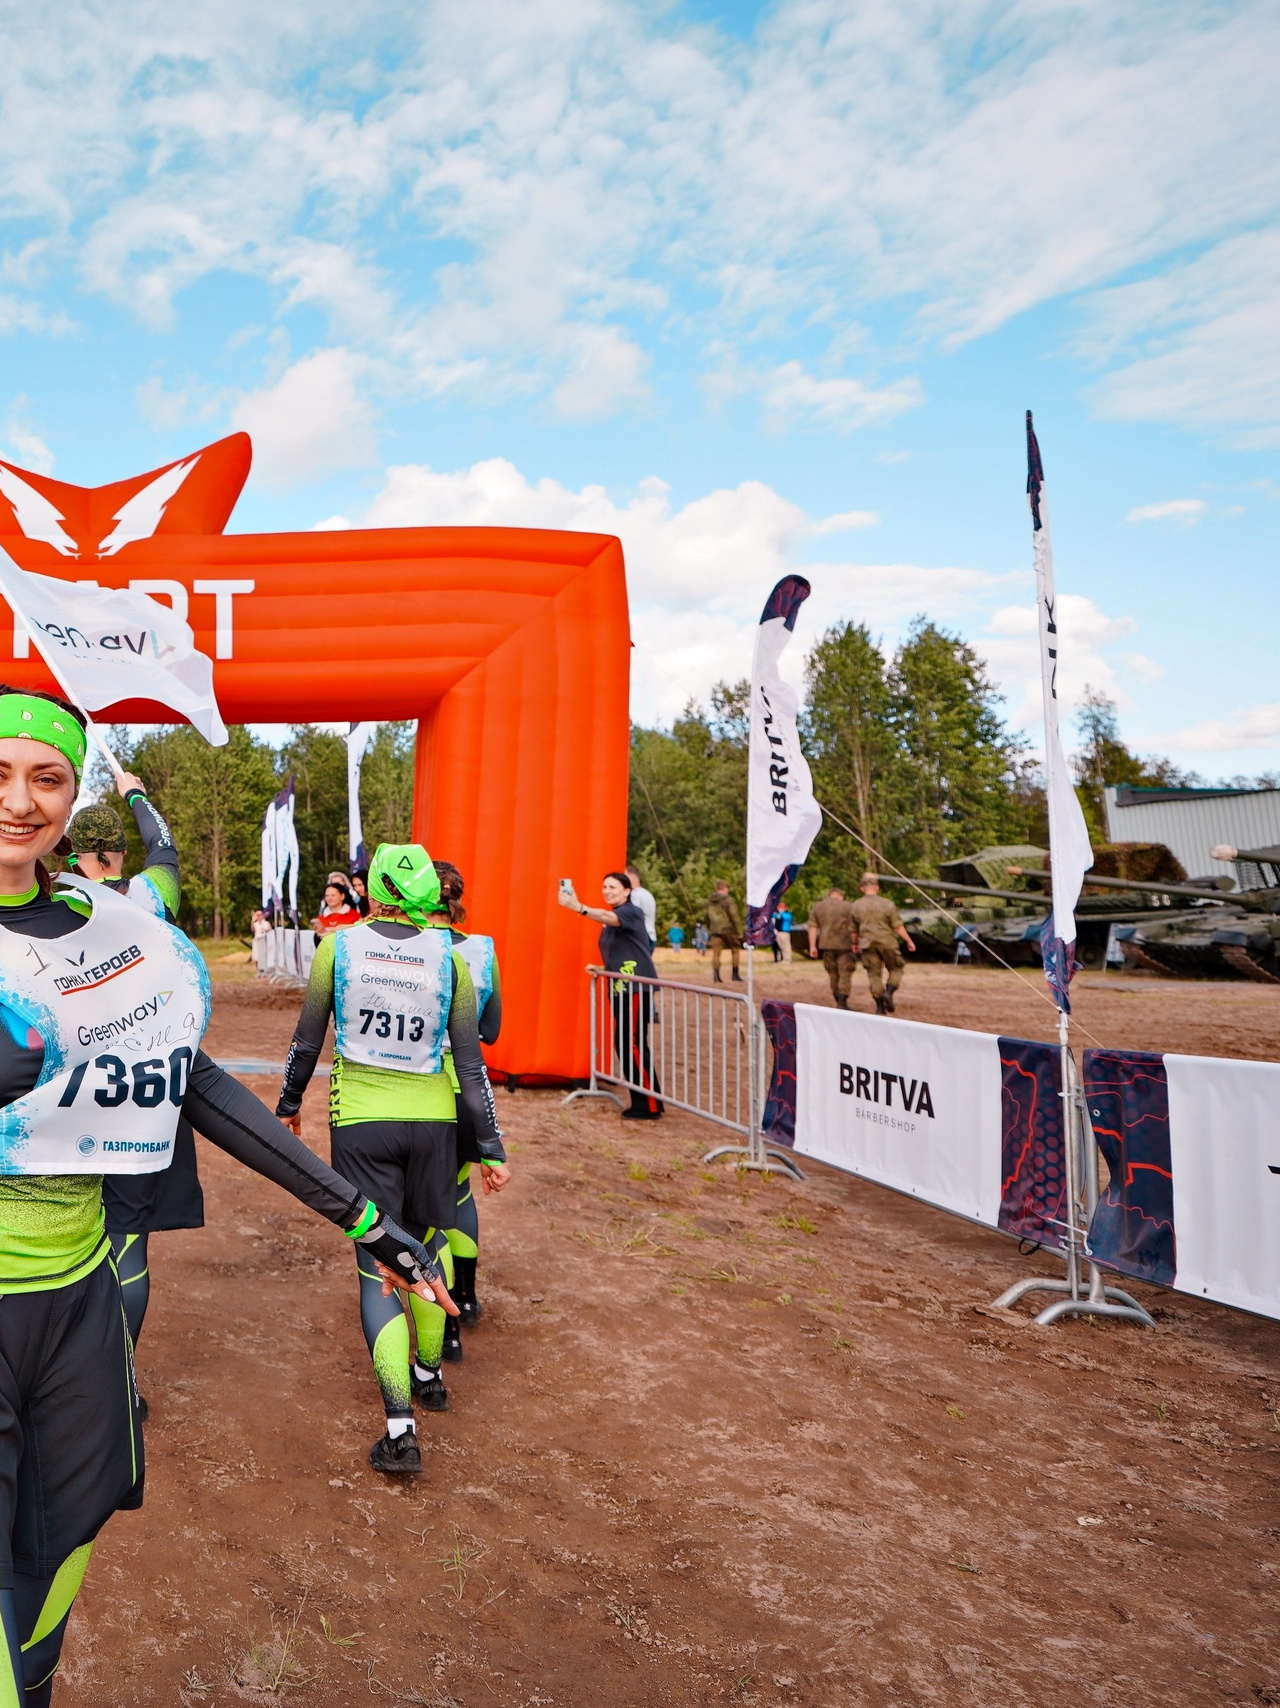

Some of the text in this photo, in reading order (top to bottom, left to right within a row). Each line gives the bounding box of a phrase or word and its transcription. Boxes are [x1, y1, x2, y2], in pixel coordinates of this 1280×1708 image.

[53, 944, 142, 991] ГОНКА ГЕРОЕВ
[365, 951, 425, 964] ГОНКА ГЕРОЕВ
[360, 973, 420, 992] Greenway
[77, 996, 159, 1047] Greenway
[359, 1008, 425, 1042] 7313
[378, 1051, 412, 1061] ГАЗПРОМБАНК
[839, 1062, 935, 1119] BRITVA
[855, 1107, 917, 1134] BARBERSHOP
[103, 1140, 171, 1153] ГАЗПРОМБАНК
